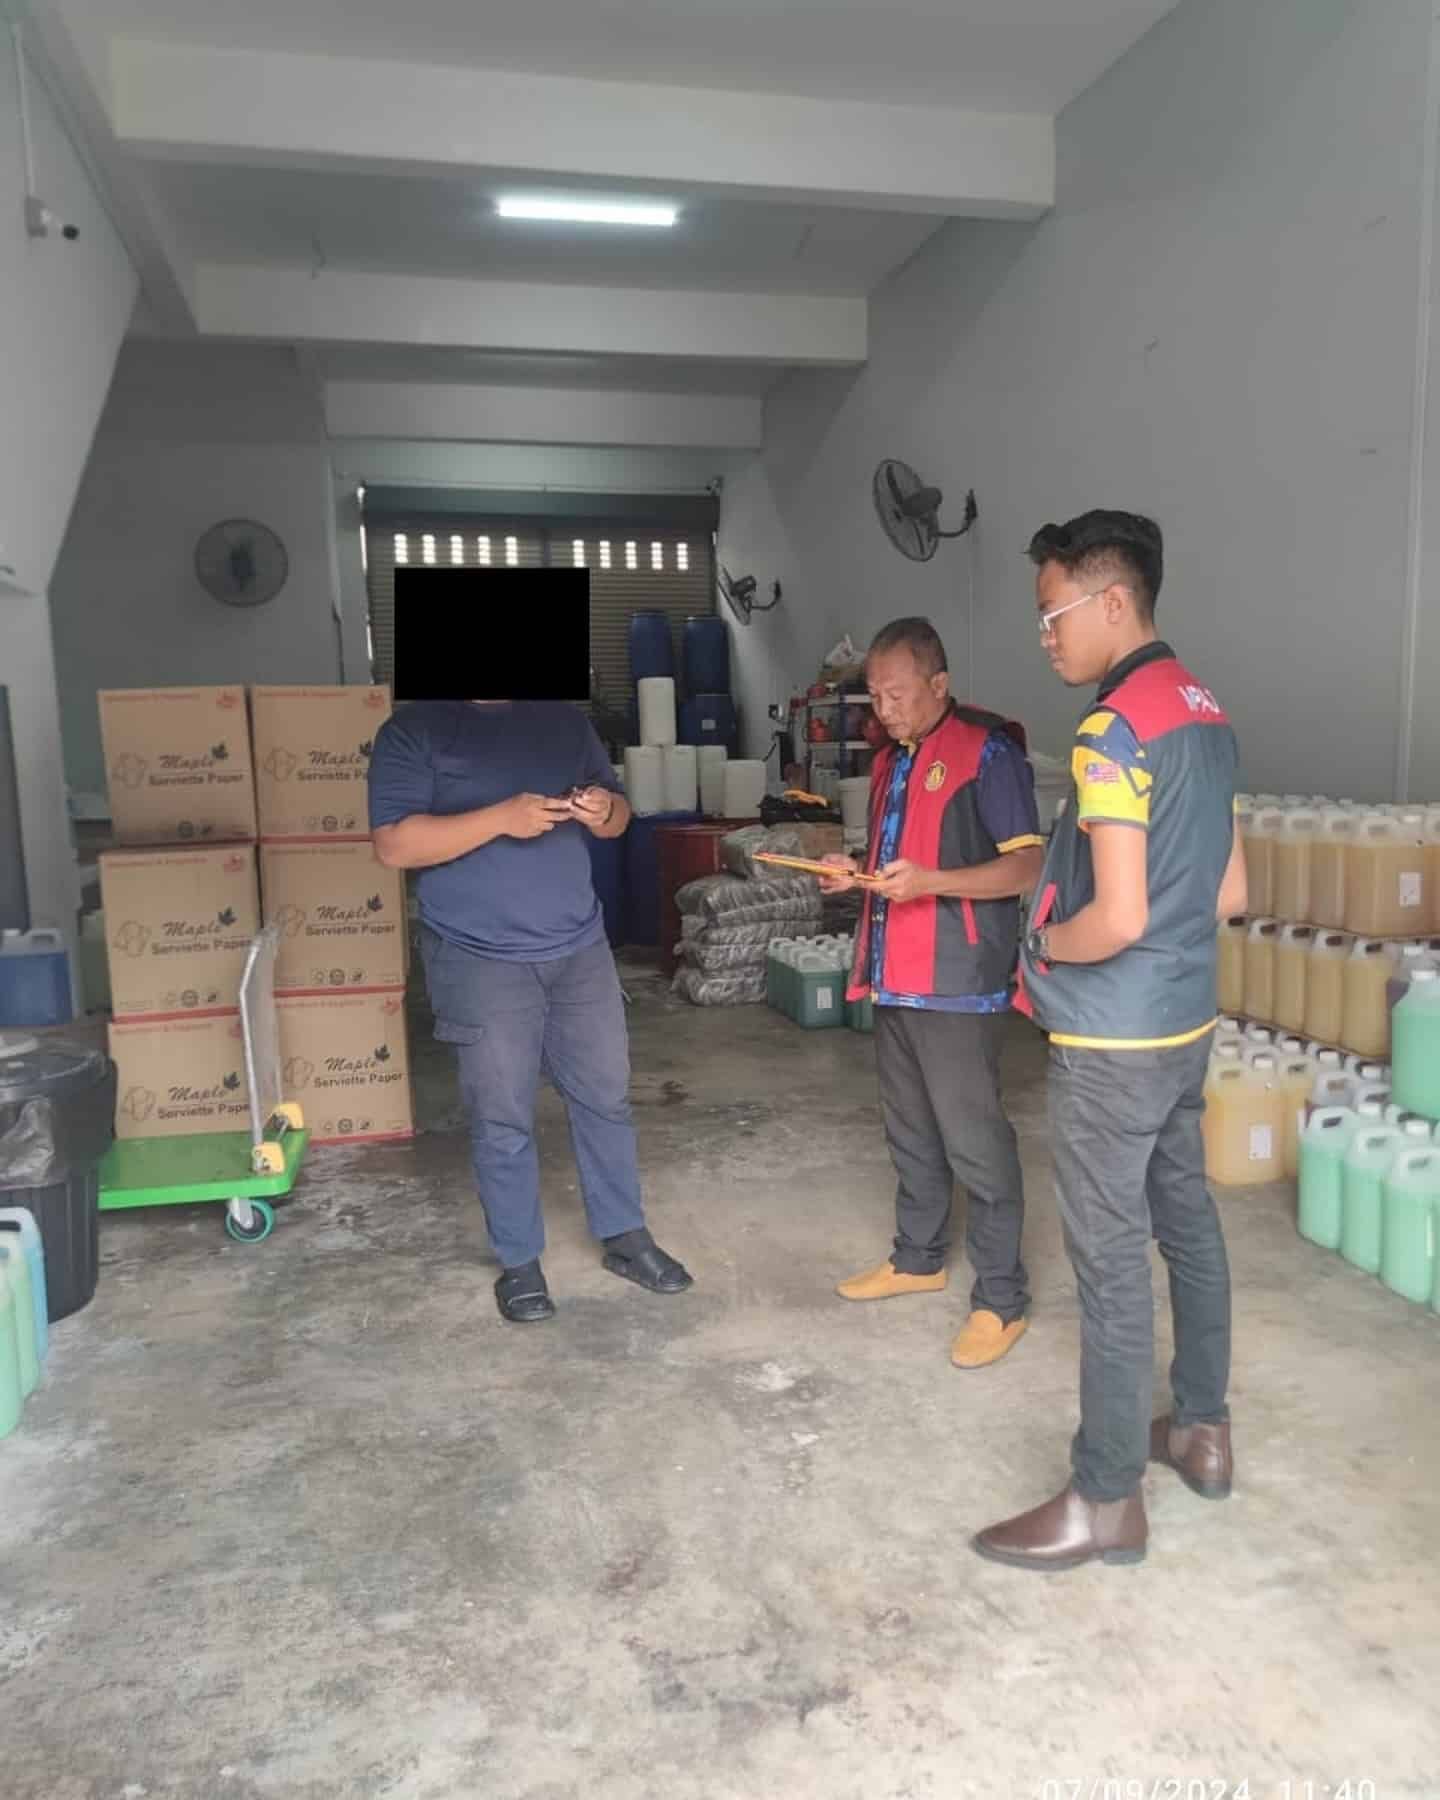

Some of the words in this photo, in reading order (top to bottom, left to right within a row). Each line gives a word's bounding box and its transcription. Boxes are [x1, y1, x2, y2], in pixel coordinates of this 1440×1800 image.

[158, 754, 215, 770] Maple
[307, 750, 362, 766] Maple
[148, 774, 204, 787] Serviette
[207, 771, 243, 785] Paper
[297, 769, 351, 782] Serviette
[316, 904, 369, 922] Maple
[162, 921, 222, 941] Maple
[305, 925, 360, 937] Serviette
[361, 924, 395, 936] Paper
[151, 941, 210, 955] Serviette
[323, 1056, 377, 1074] Maple
[313, 1075, 366, 1088] Serviette
[369, 1072, 403, 1085] Paper
[168, 1084, 226, 1103] Maple
[157, 1104, 214, 1119] Serviette
[217, 1101, 250, 1115] Pape
